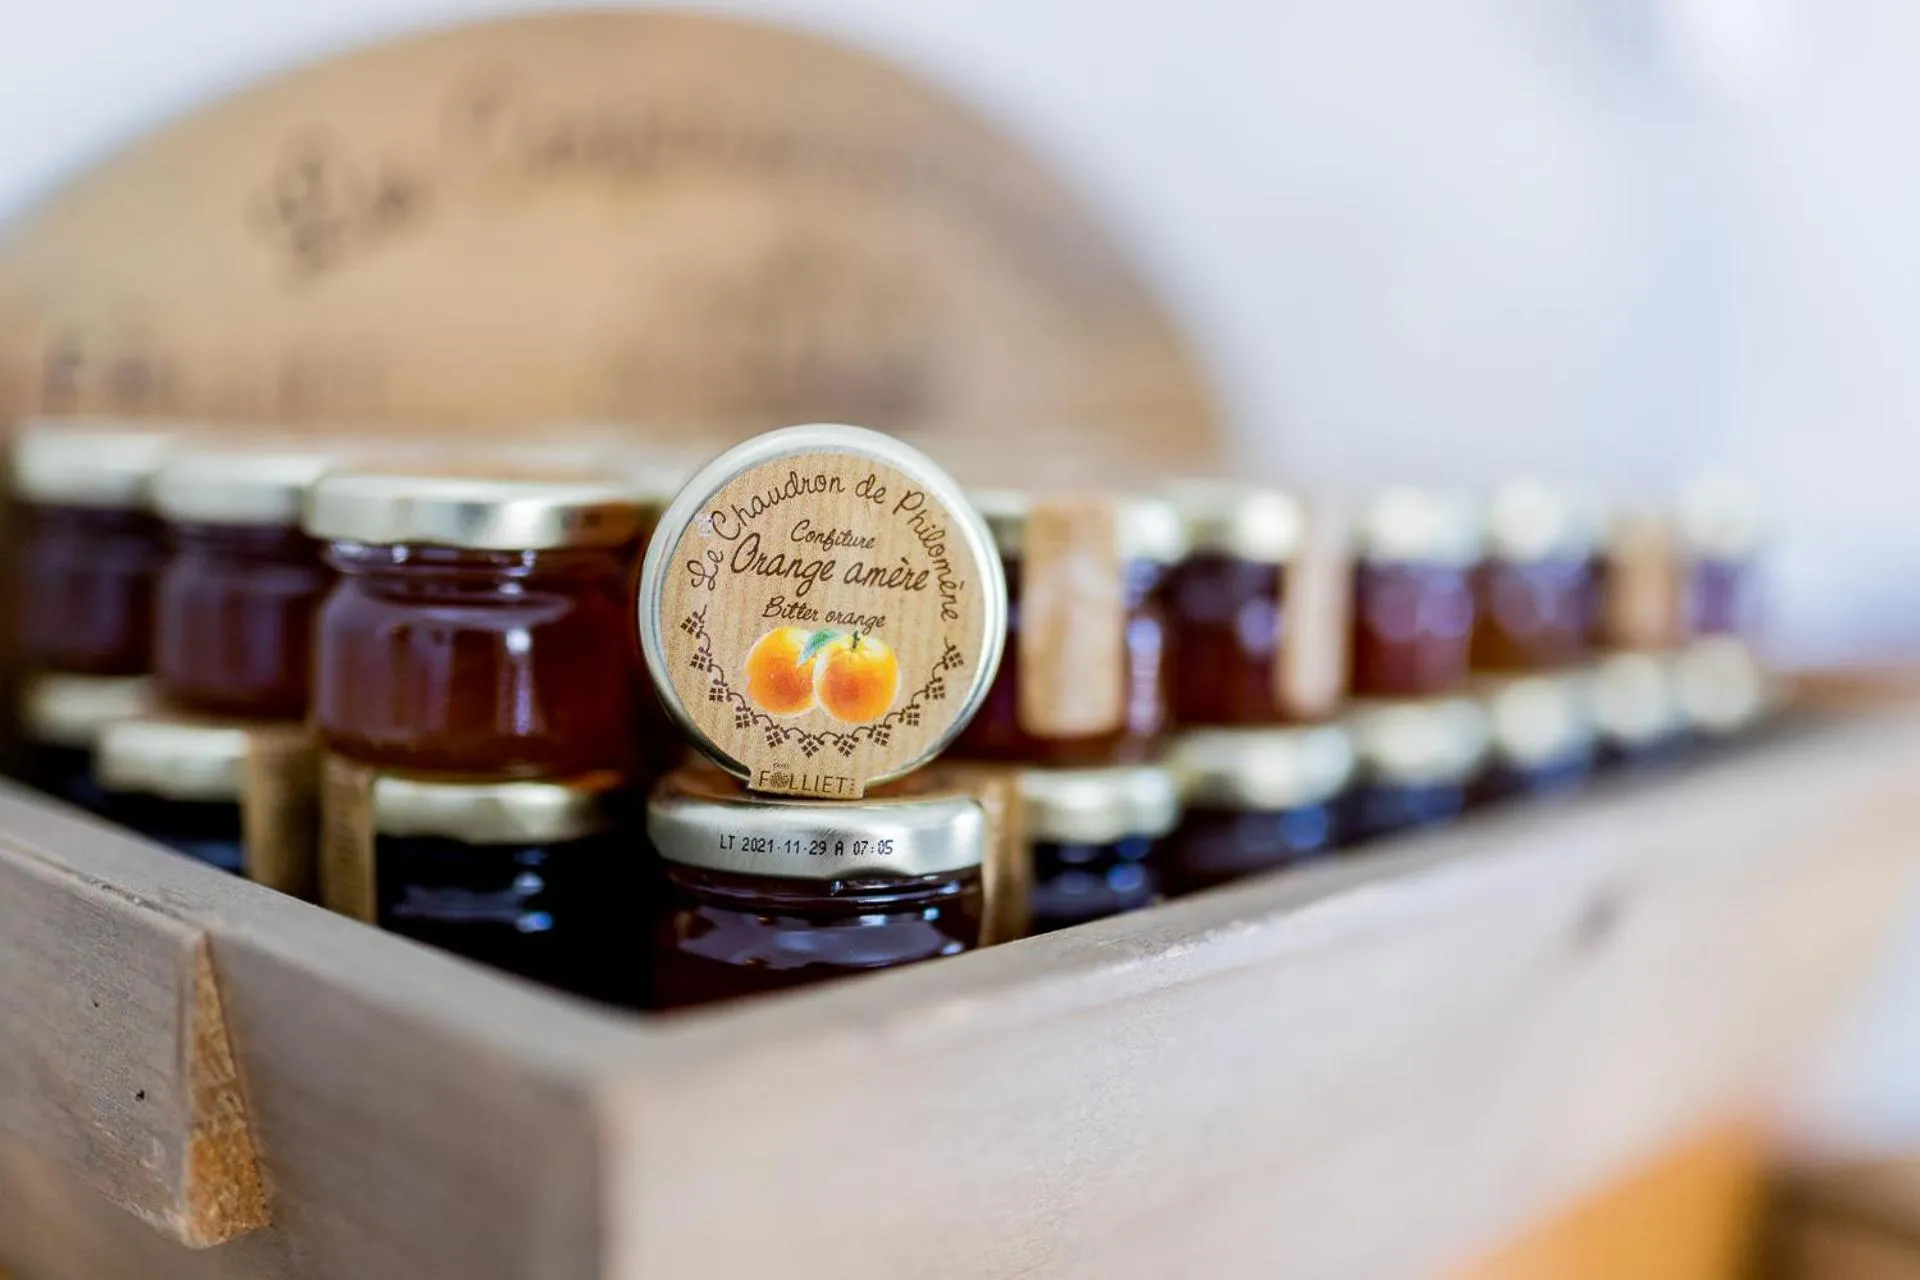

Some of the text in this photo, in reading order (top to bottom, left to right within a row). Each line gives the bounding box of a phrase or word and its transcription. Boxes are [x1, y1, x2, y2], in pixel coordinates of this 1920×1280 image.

[686, 549, 724, 592] Le
[710, 470, 846, 541] Chaudron
[854, 473, 886, 504] de
[790, 519, 875, 551] Confiture
[730, 531, 930, 598] Orange amère
[761, 595, 886, 636] Bitter orange
[758, 769, 849, 794] FOLLIET
[719, 833, 736, 850] LT
[834, 840, 845, 856] A
[852, 839, 894, 856] 07:05
